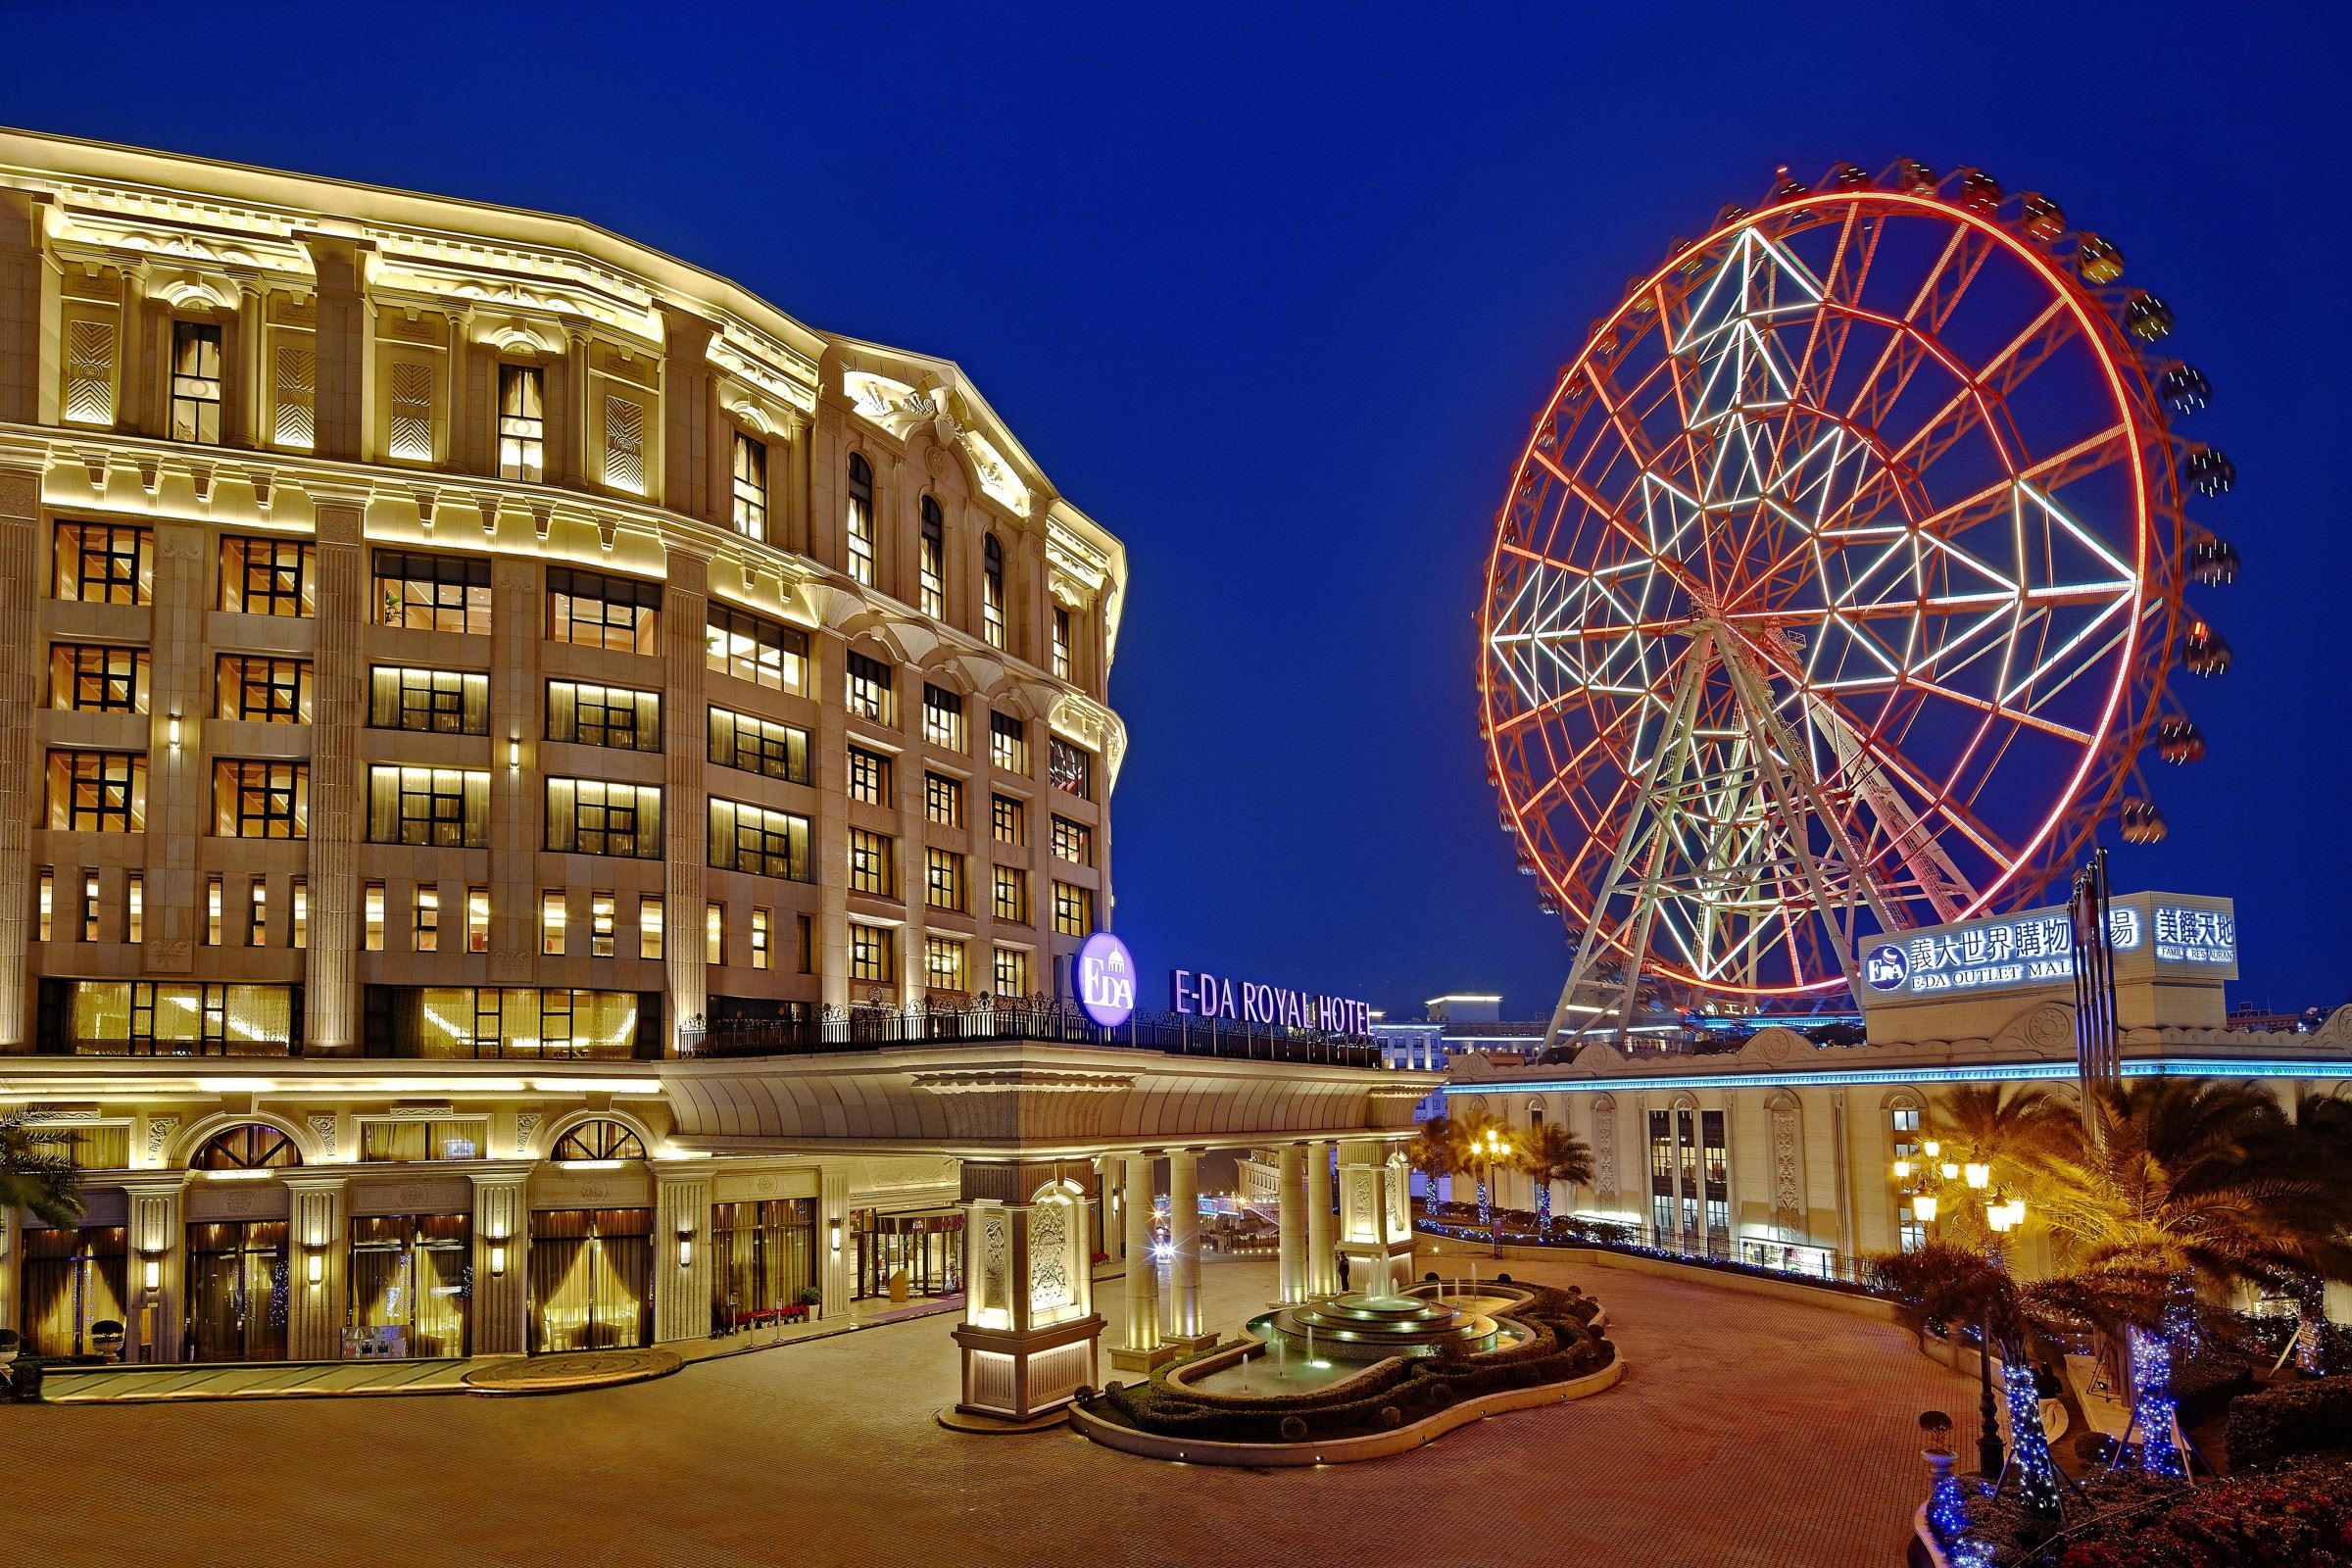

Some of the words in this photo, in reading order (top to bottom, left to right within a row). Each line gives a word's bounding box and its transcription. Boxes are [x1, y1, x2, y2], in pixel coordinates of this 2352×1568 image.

[1910, 911, 2134, 970] 義大世界購物場
[2159, 909, 2235, 946] 美饌天地
[1912, 975, 1946, 989] E-DA
[1953, 966, 2020, 984] OUTLET
[2029, 960, 2075, 977] MAL
[2162, 948, 2186, 957] FAMILY
[2191, 950, 2234, 960] RESTAURANT
[1083, 956, 1134, 1009] EDA
[1175, 969, 1236, 1019] E-DA
[1243, 981, 1313, 1029] ROYAL
[1319, 995, 1375, 1037] HOTEL
